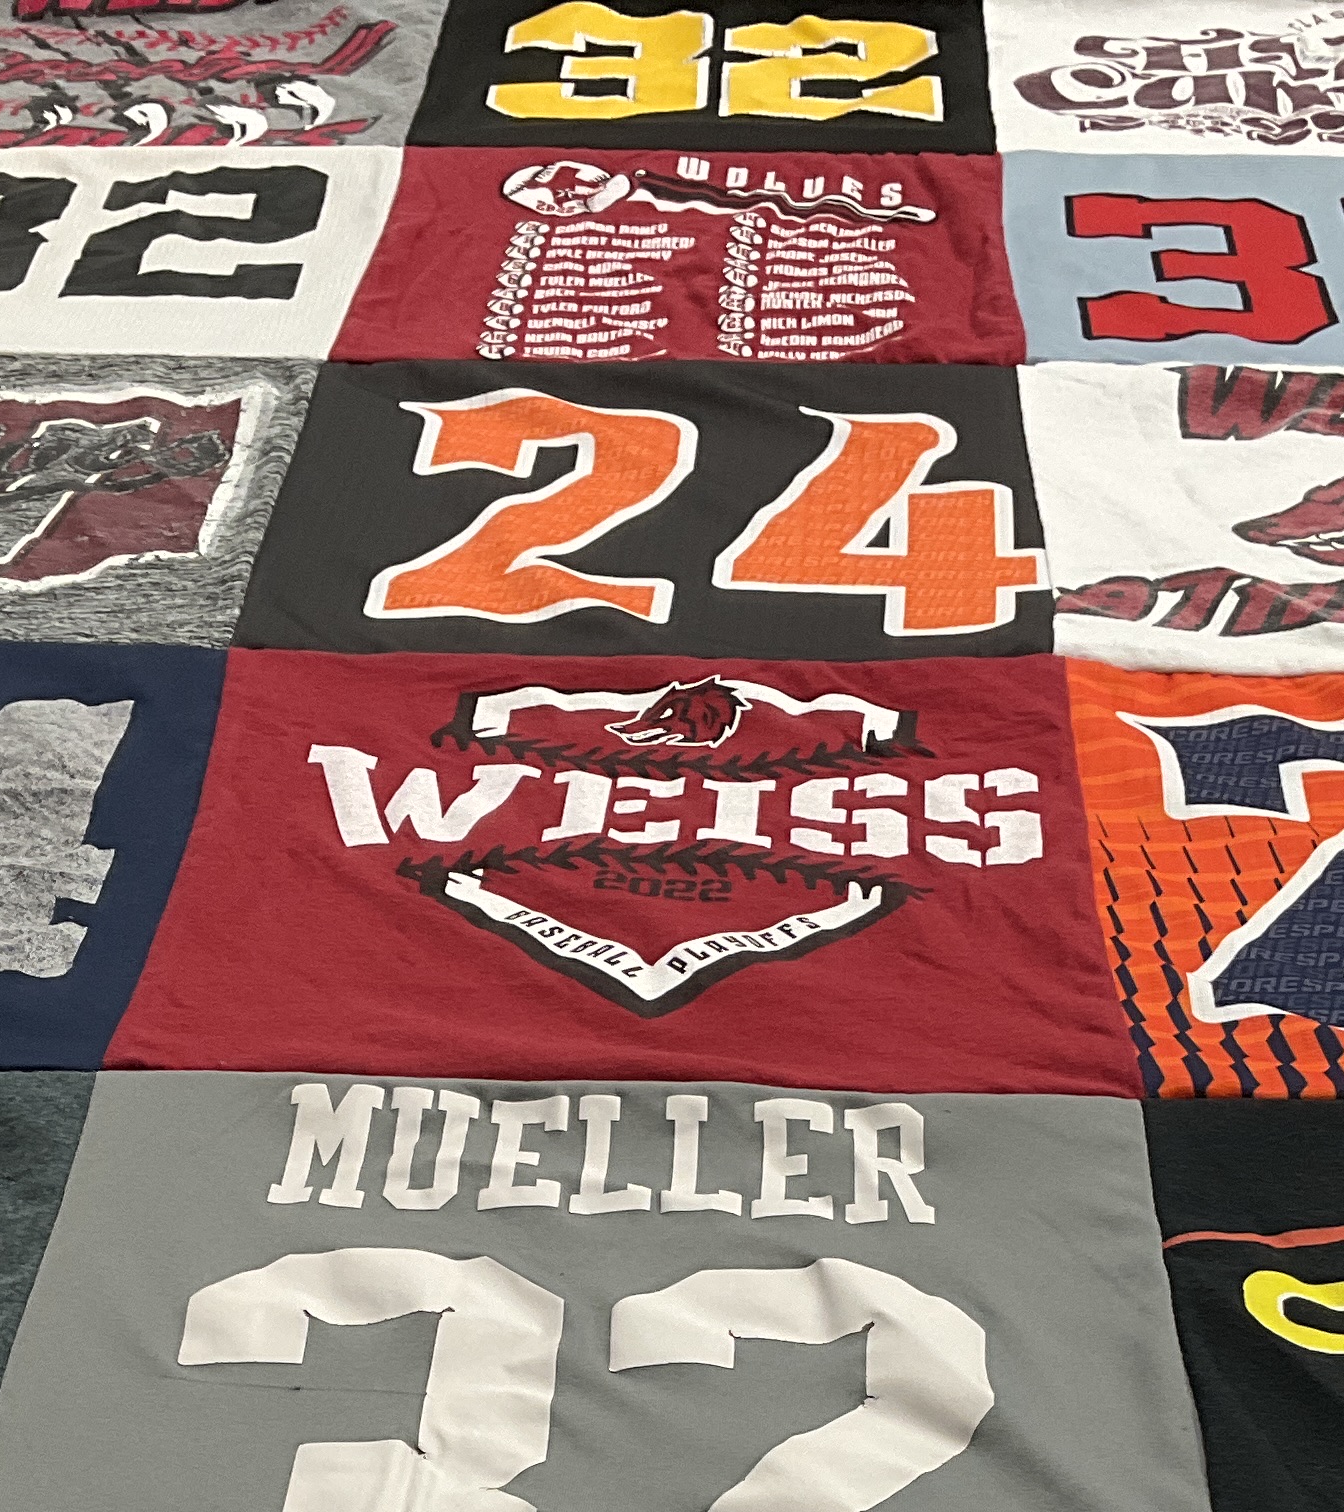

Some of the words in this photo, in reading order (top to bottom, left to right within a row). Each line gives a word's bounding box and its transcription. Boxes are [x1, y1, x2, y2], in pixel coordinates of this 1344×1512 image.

[486, 1, 944, 121] 32
[362, 387, 1056, 637] 24
[306, 743, 1044, 868] WEISS
[505, 909, 645, 979] BASEBALL
[665, 915, 821, 976] PLAYOFFS
[592, 869, 733, 903] 2022
[265, 1082, 937, 1226] MUELLER
